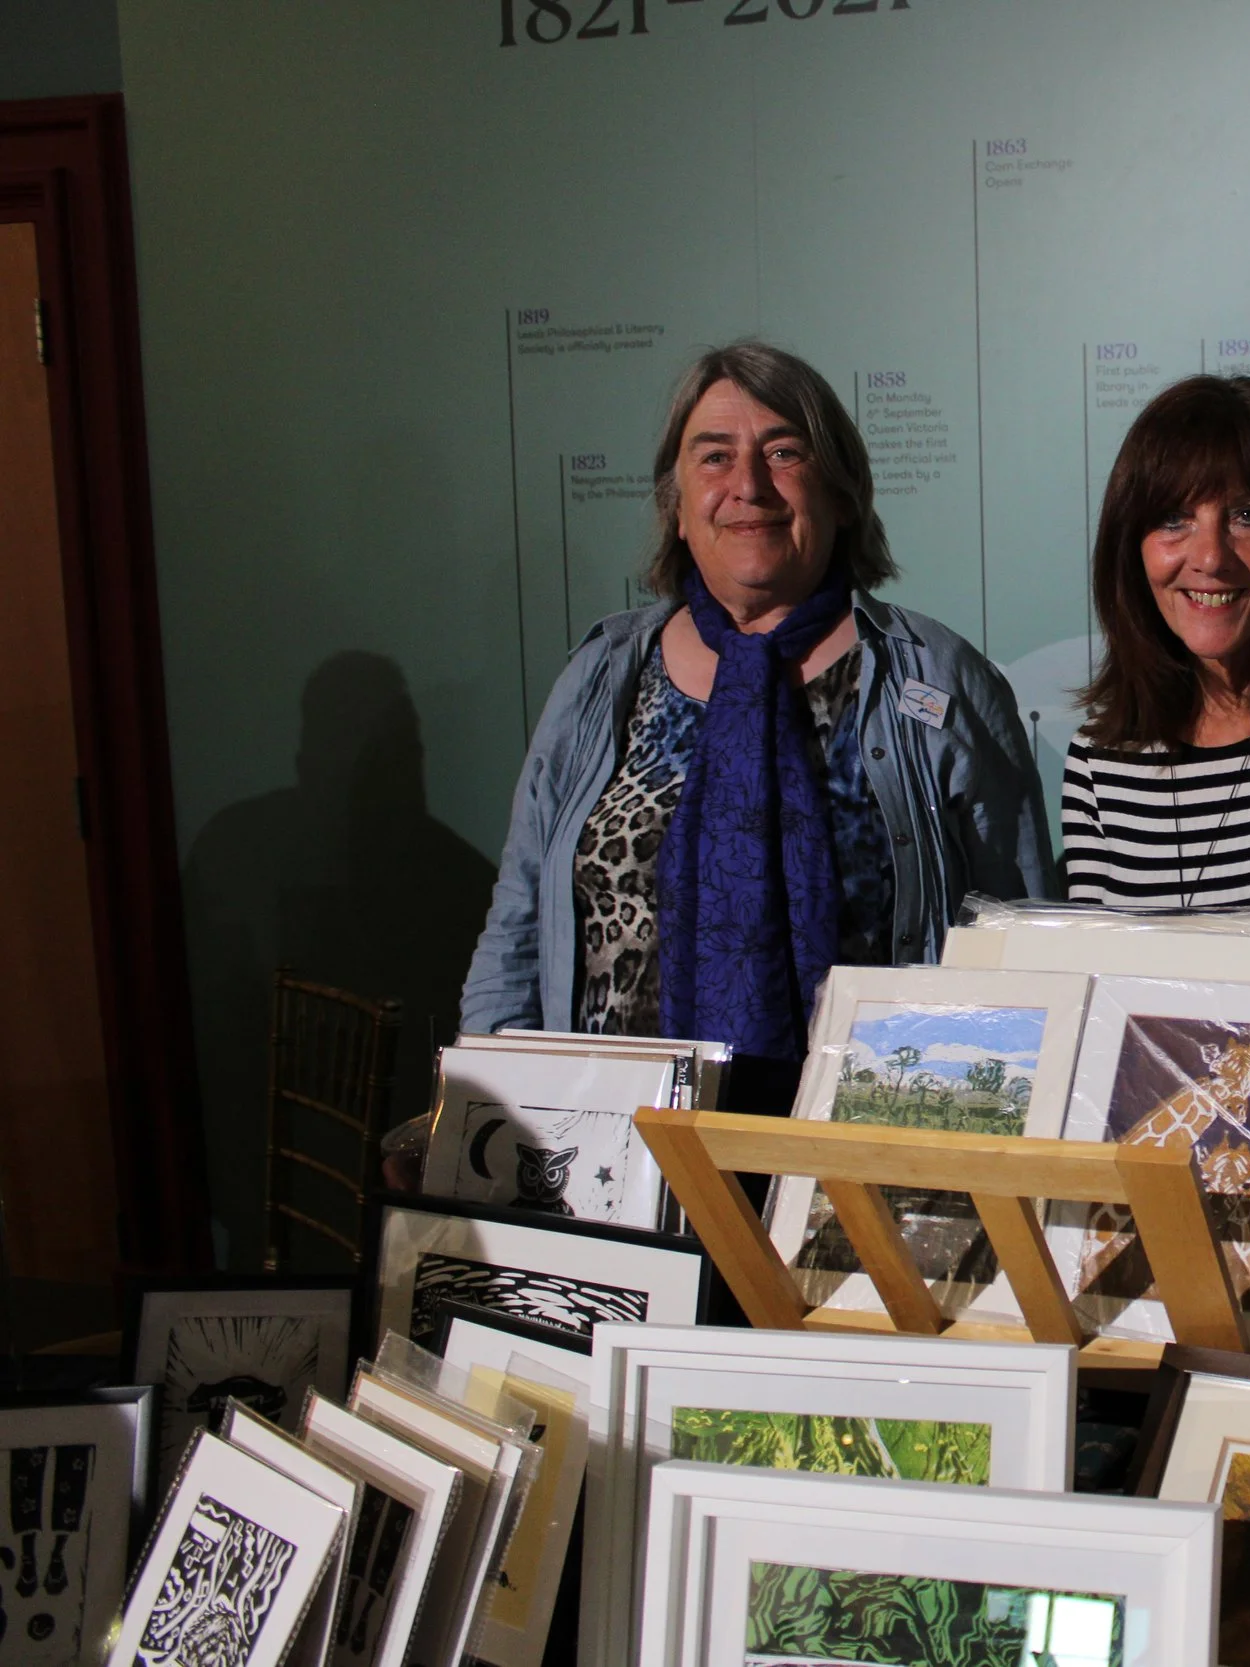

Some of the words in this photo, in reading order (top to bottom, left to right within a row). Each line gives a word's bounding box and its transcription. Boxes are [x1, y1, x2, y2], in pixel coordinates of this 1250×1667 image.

[986, 138, 1027, 157] 1863
[985, 161, 1014, 173] Corn
[1017, 158, 1075, 172] Exchange
[985, 177, 1022, 189] Opens
[517, 308, 550, 325] 1819
[1096, 343, 1138, 361] 1870
[1096, 365, 1121, 377] First
[1124, 364, 1160, 379] public
[868, 371, 906, 388] 1858
[1096, 382, 1135, 394] library
[1138, 381, 1148, 391] in
[867, 392, 883, 403] On
[886, 391, 932, 405] Monday
[1096, 398, 1129, 409] Leeds
[884, 407, 942, 420] September
[868, 423, 904, 436] Queen
[907, 421, 949, 433] Victoria
[868, 440, 902, 450] makes
[905, 437, 923, 449] the
[926, 437, 947, 448] first
[572, 454, 606, 470] 1823
[893, 452, 932, 464] official
[935, 452, 957, 463] visit
[883, 470, 913, 480] Leeds
[916, 468, 930, 483] by
[932, 470, 941, 479] a
